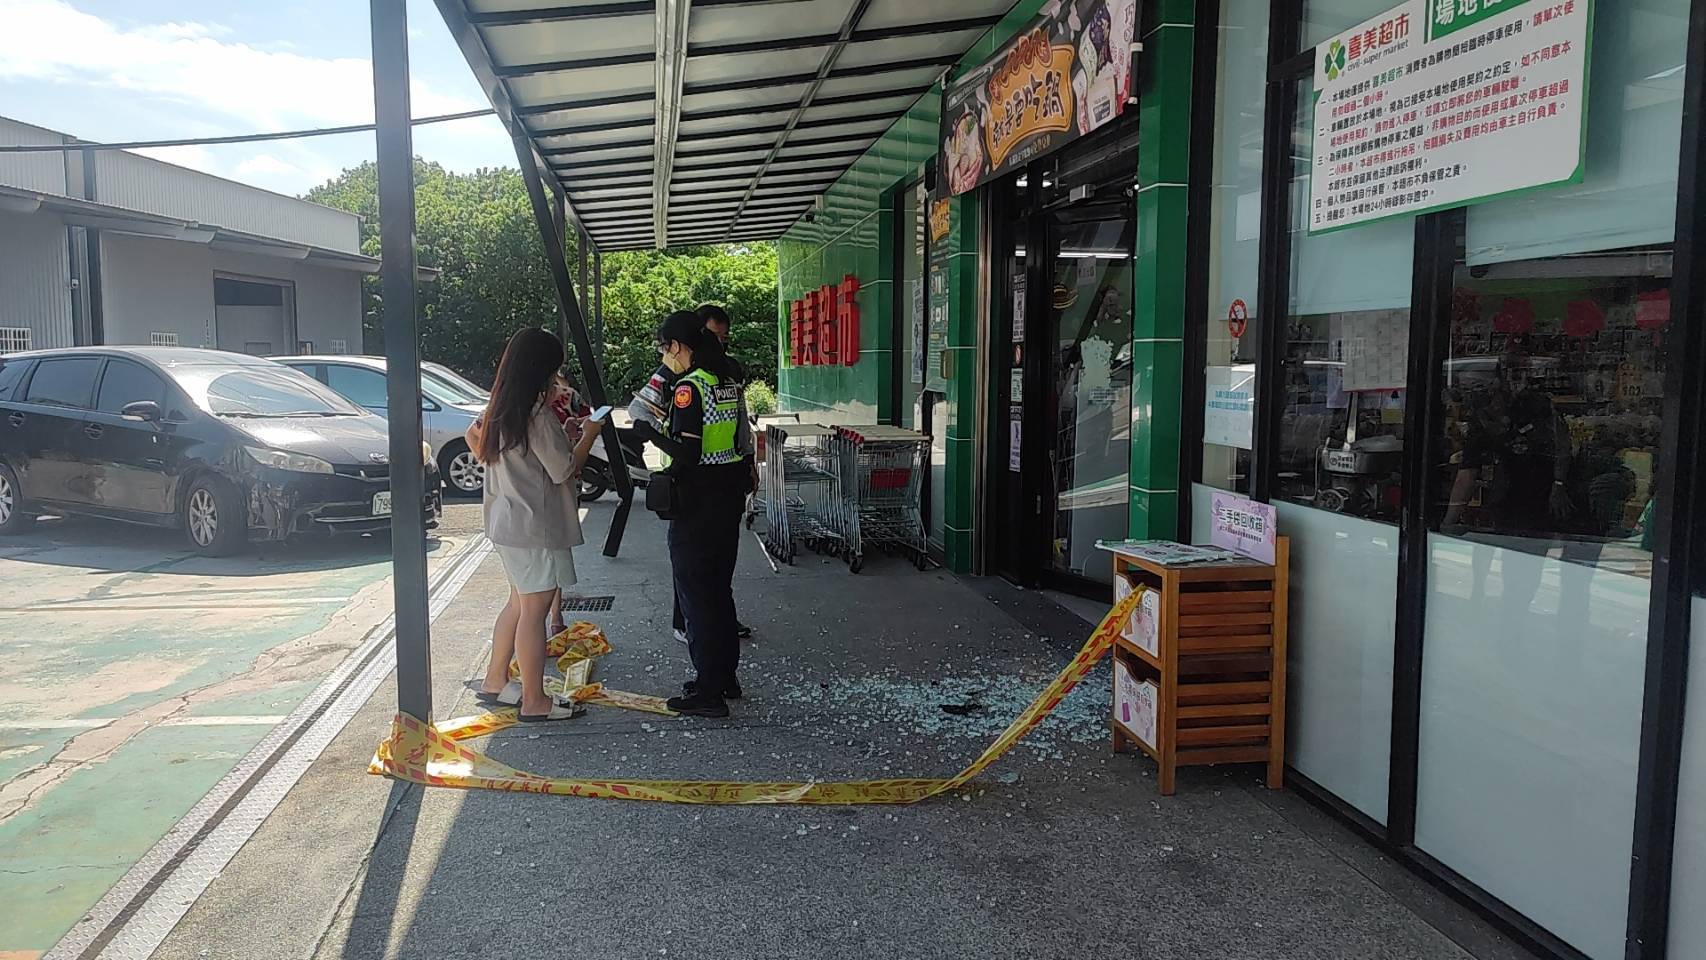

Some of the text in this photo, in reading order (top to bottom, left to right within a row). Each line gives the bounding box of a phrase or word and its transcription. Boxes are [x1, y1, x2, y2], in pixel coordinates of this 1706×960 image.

[1348, 13, 1410, 60] 喜美超市
[1383, 39, 1409, 57] market
[716, 388, 737, 399] POLICE
